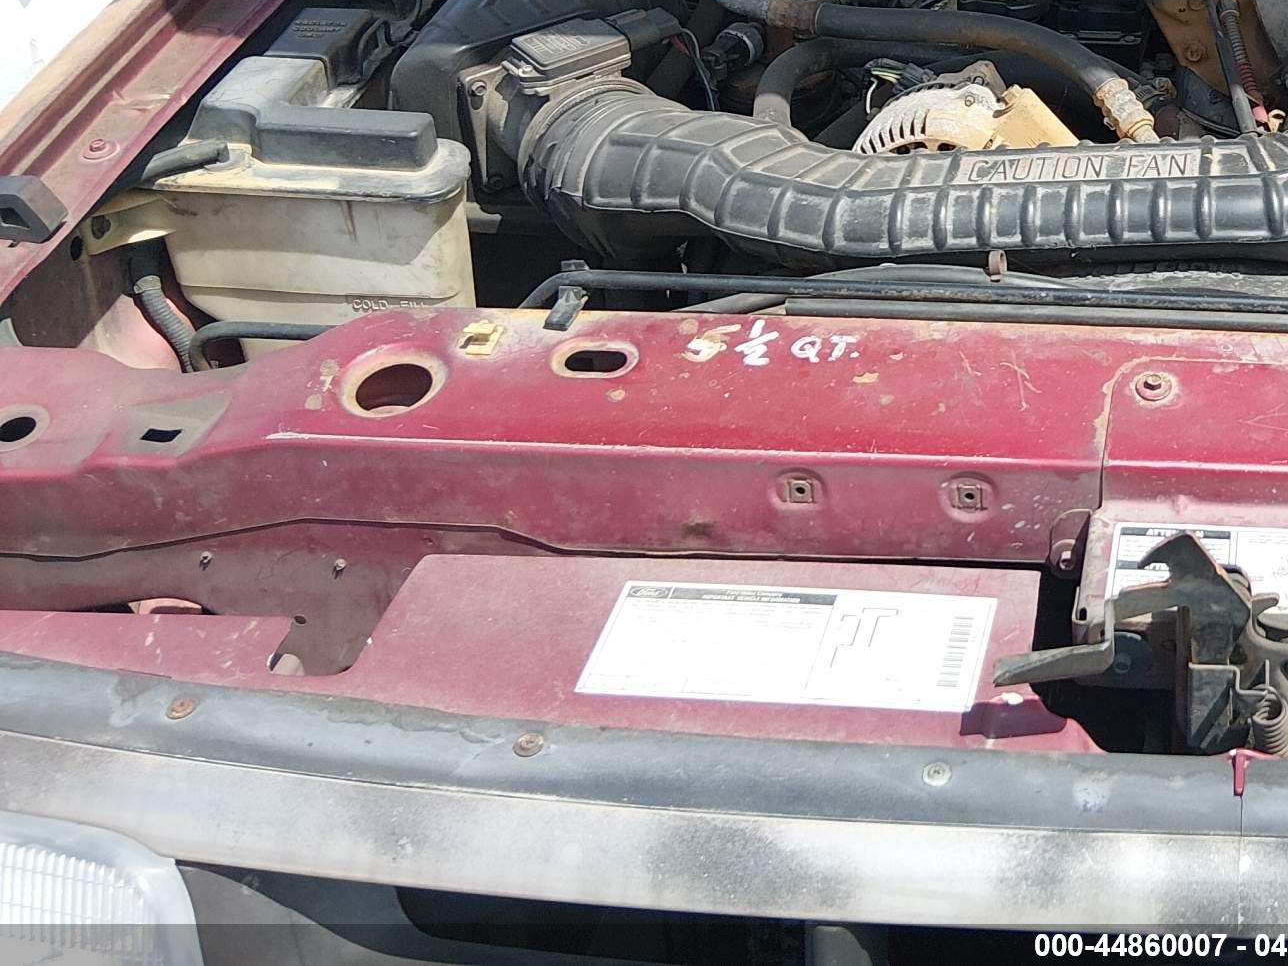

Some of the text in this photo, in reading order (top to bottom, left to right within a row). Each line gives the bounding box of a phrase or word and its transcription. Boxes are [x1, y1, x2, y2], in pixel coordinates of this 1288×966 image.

[968, 153, 1188, 183] CAUTION FAN
[352, 299, 389, 311] COLD
